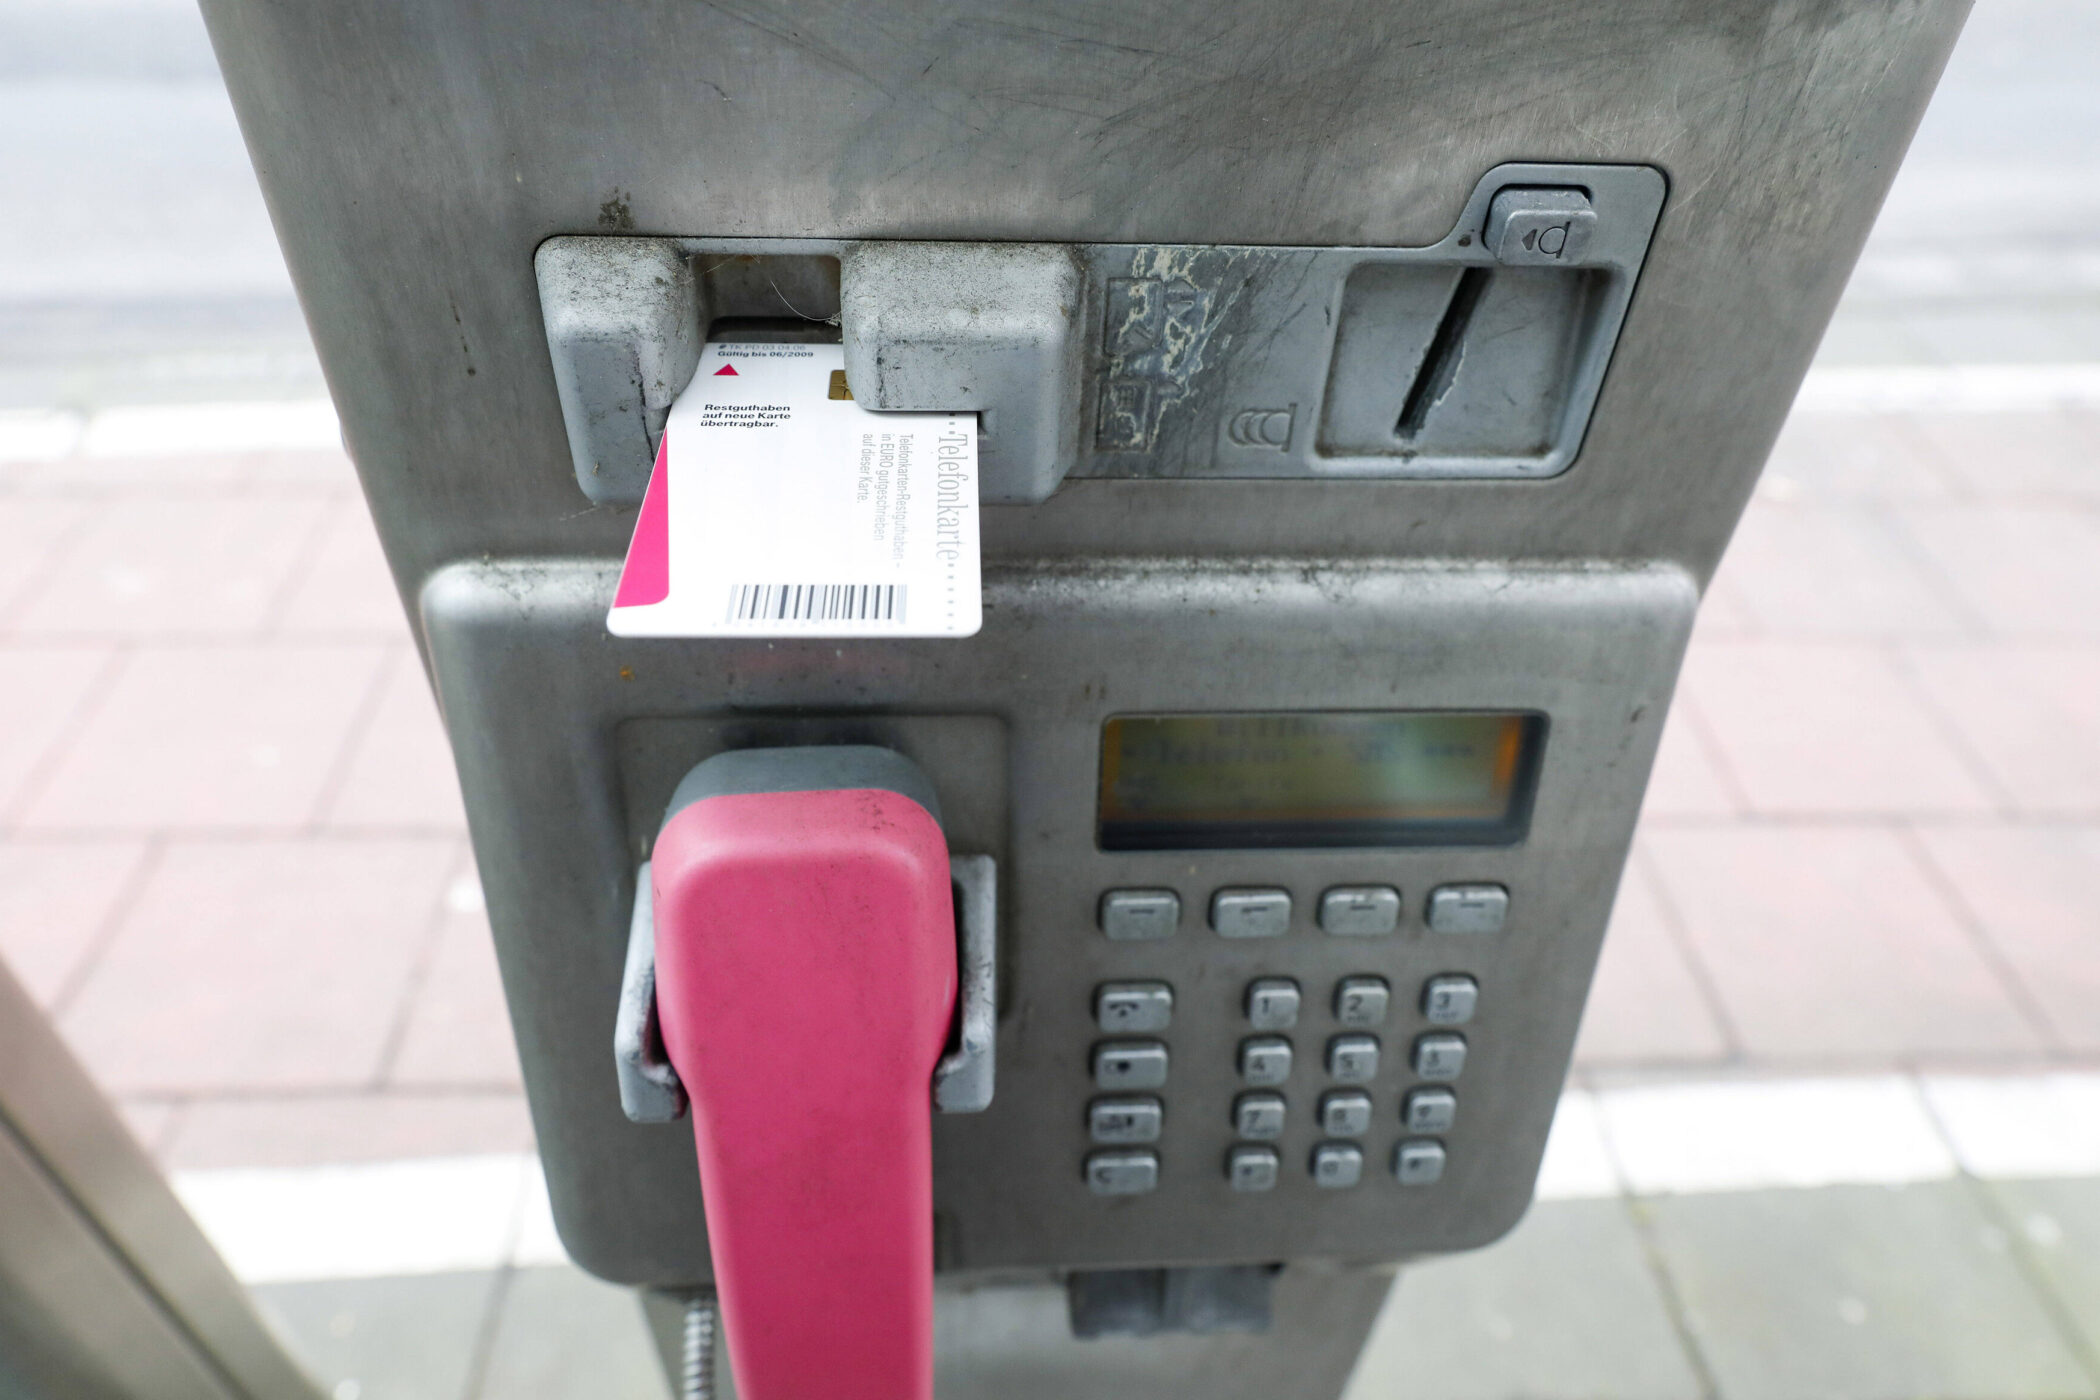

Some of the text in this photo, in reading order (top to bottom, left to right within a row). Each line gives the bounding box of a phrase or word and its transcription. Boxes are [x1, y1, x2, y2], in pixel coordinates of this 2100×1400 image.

[717, 350, 750, 358] Gültig
[704, 404, 791, 412] Restguthaben
[700, 420, 779, 428] übertragbar.
[857, 433, 876, 504] auf dieser Karte.
[873, 433, 896, 542] in EURO gutgeschrieben
[892, 433, 914, 560] Telefonkarten-Restguthaben
[936, 433, 969, 560] Telefonkarte
[1260, 996, 1272, 1014] 1
[1347, 994, 1364, 1012] 2
